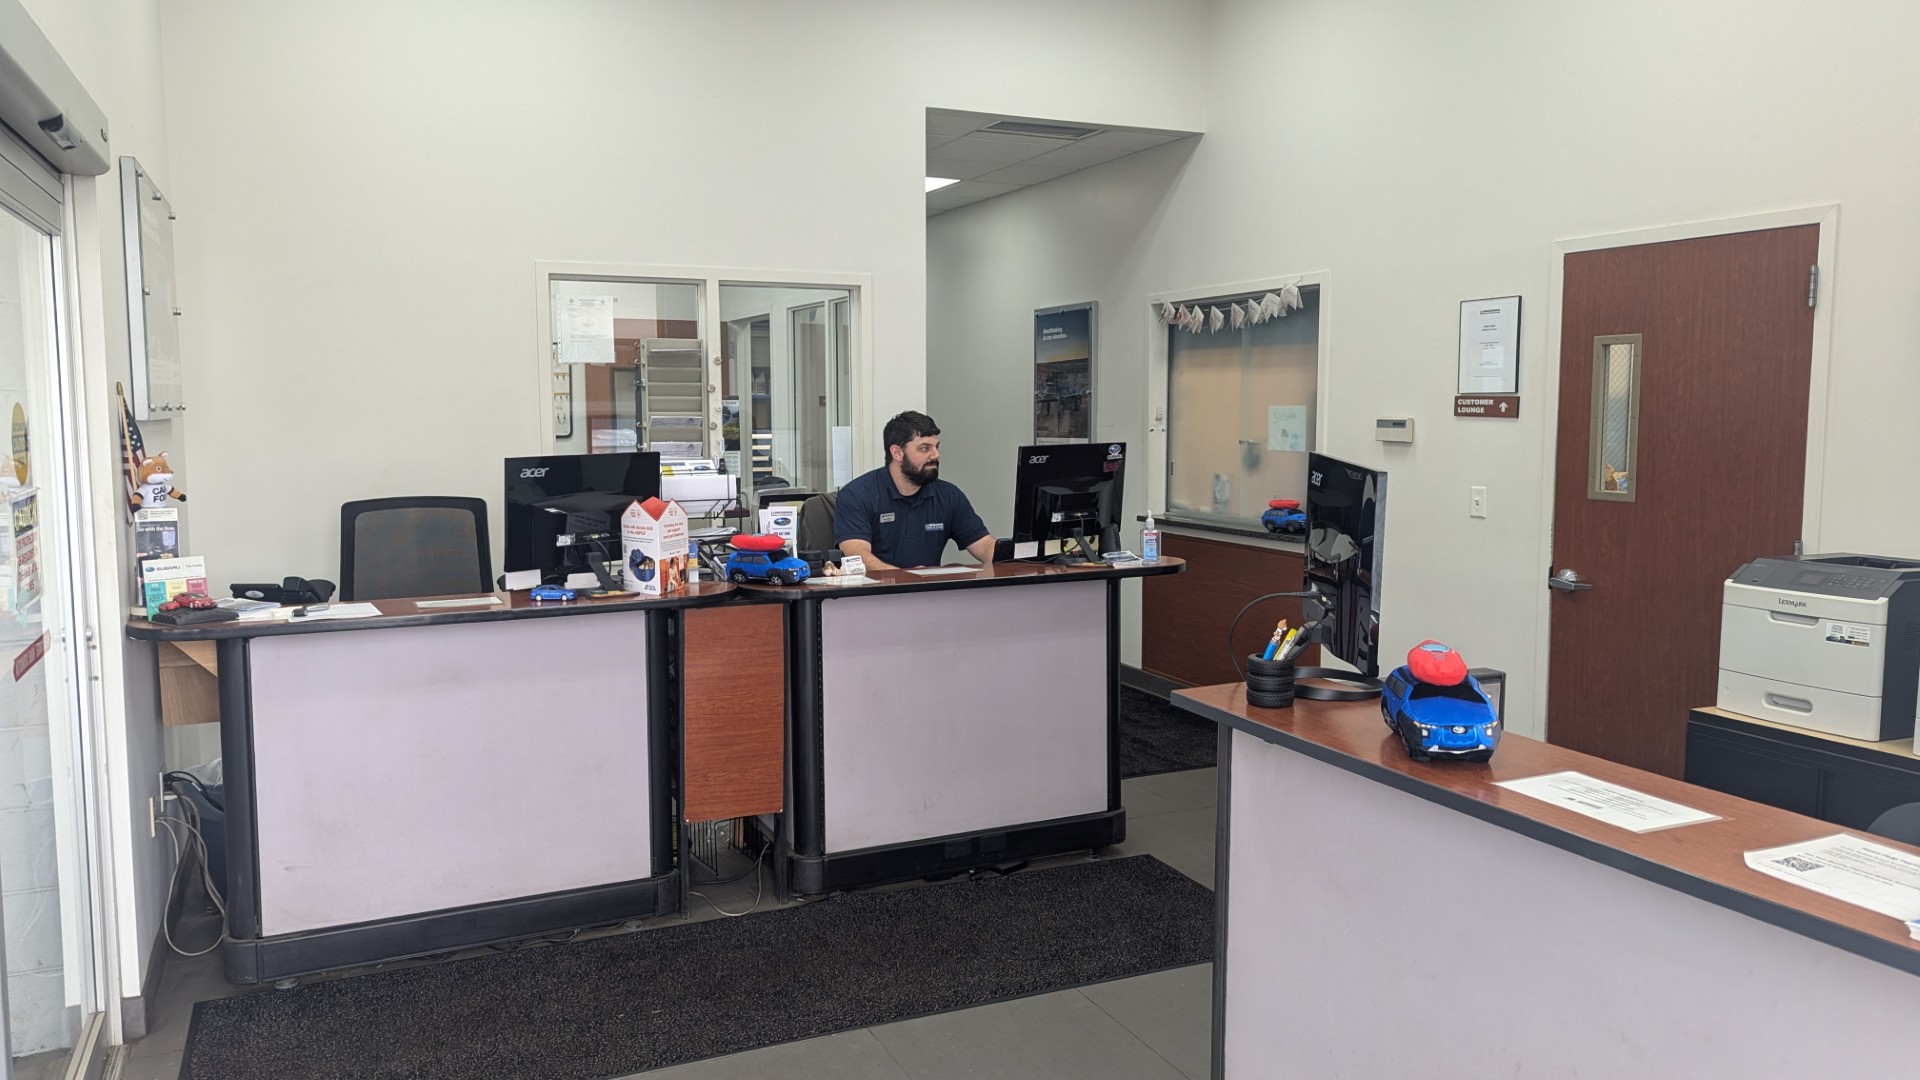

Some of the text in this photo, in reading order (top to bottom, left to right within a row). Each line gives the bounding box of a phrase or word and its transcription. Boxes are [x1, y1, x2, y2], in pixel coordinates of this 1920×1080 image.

[1028, 454, 1050, 464] acer
[520, 467, 550, 478] acer
[1311, 470, 1323, 487] acer
